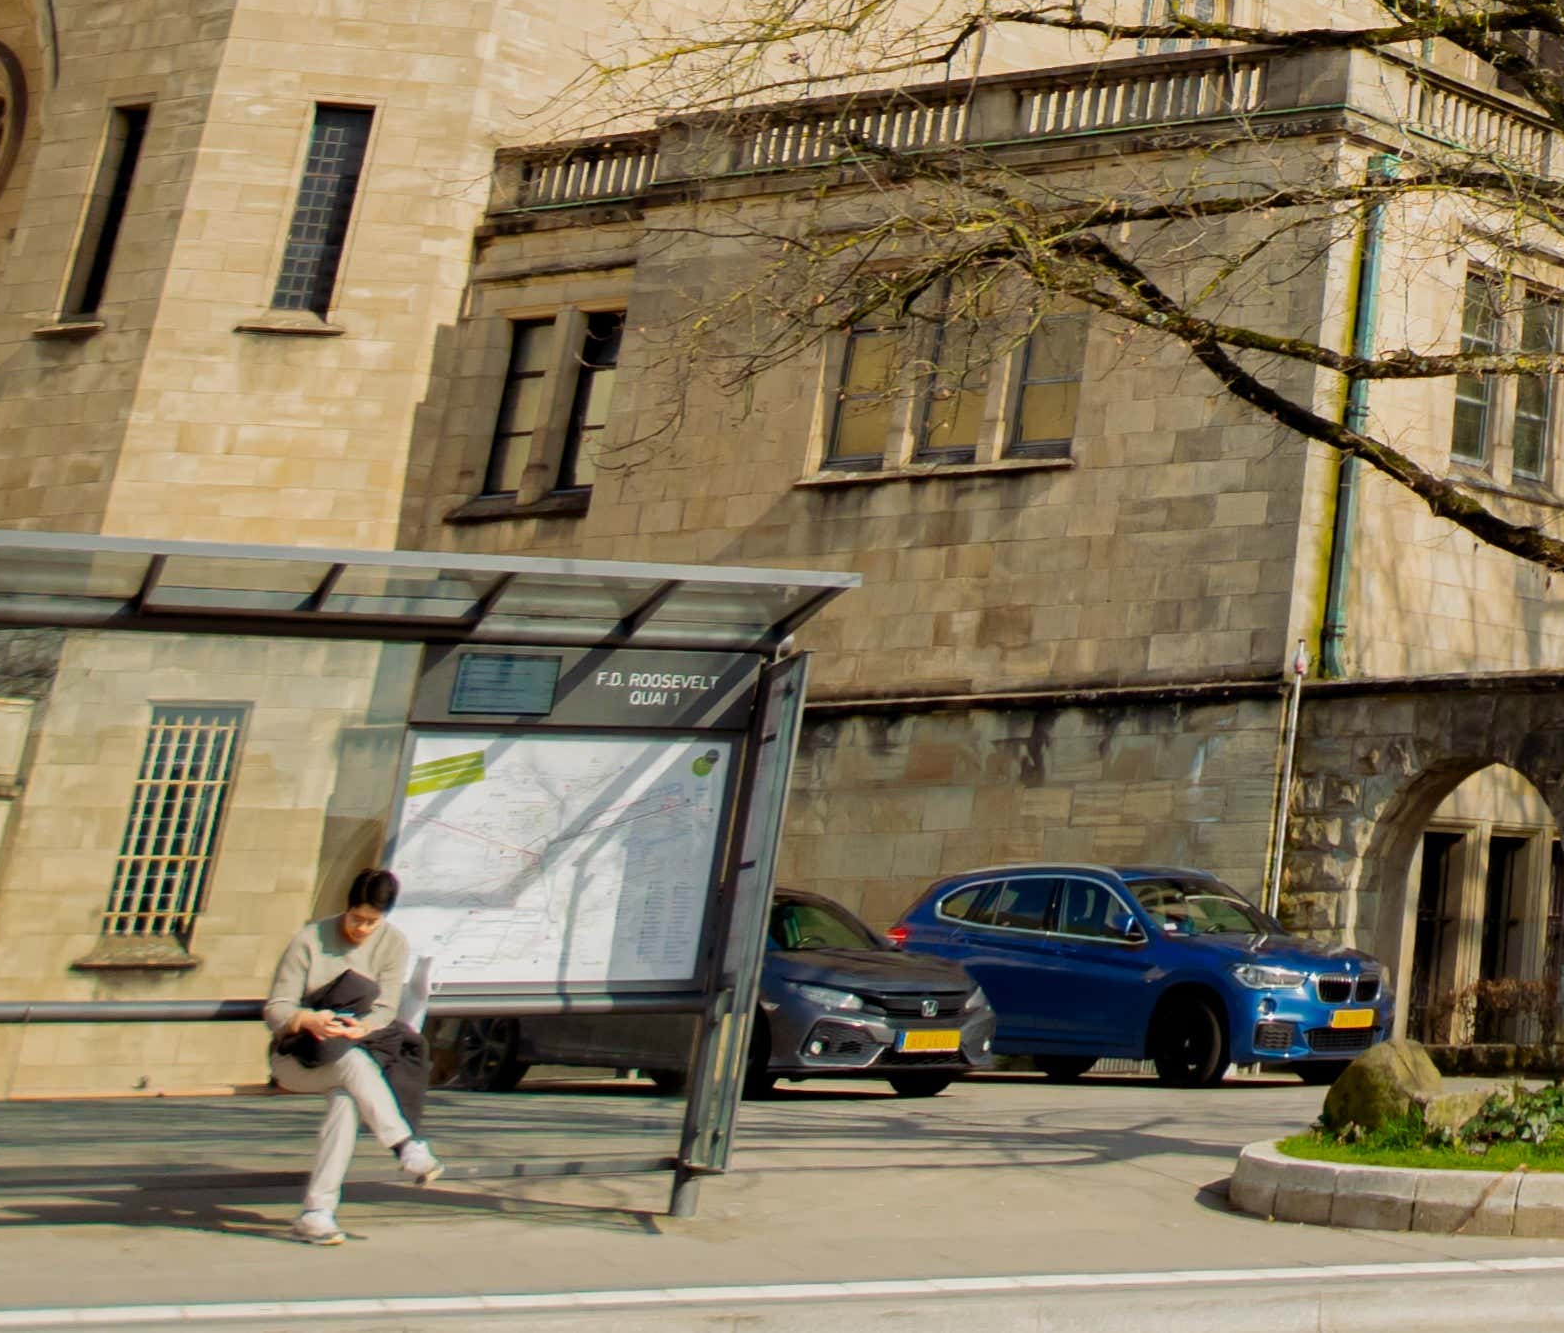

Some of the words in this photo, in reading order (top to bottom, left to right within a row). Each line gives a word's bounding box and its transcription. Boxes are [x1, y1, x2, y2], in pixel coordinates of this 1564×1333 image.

[628, 673, 720, 690] ROOSEVELT
[629, 691, 668, 706] QUAI
[672, 692, 681, 706] 1
